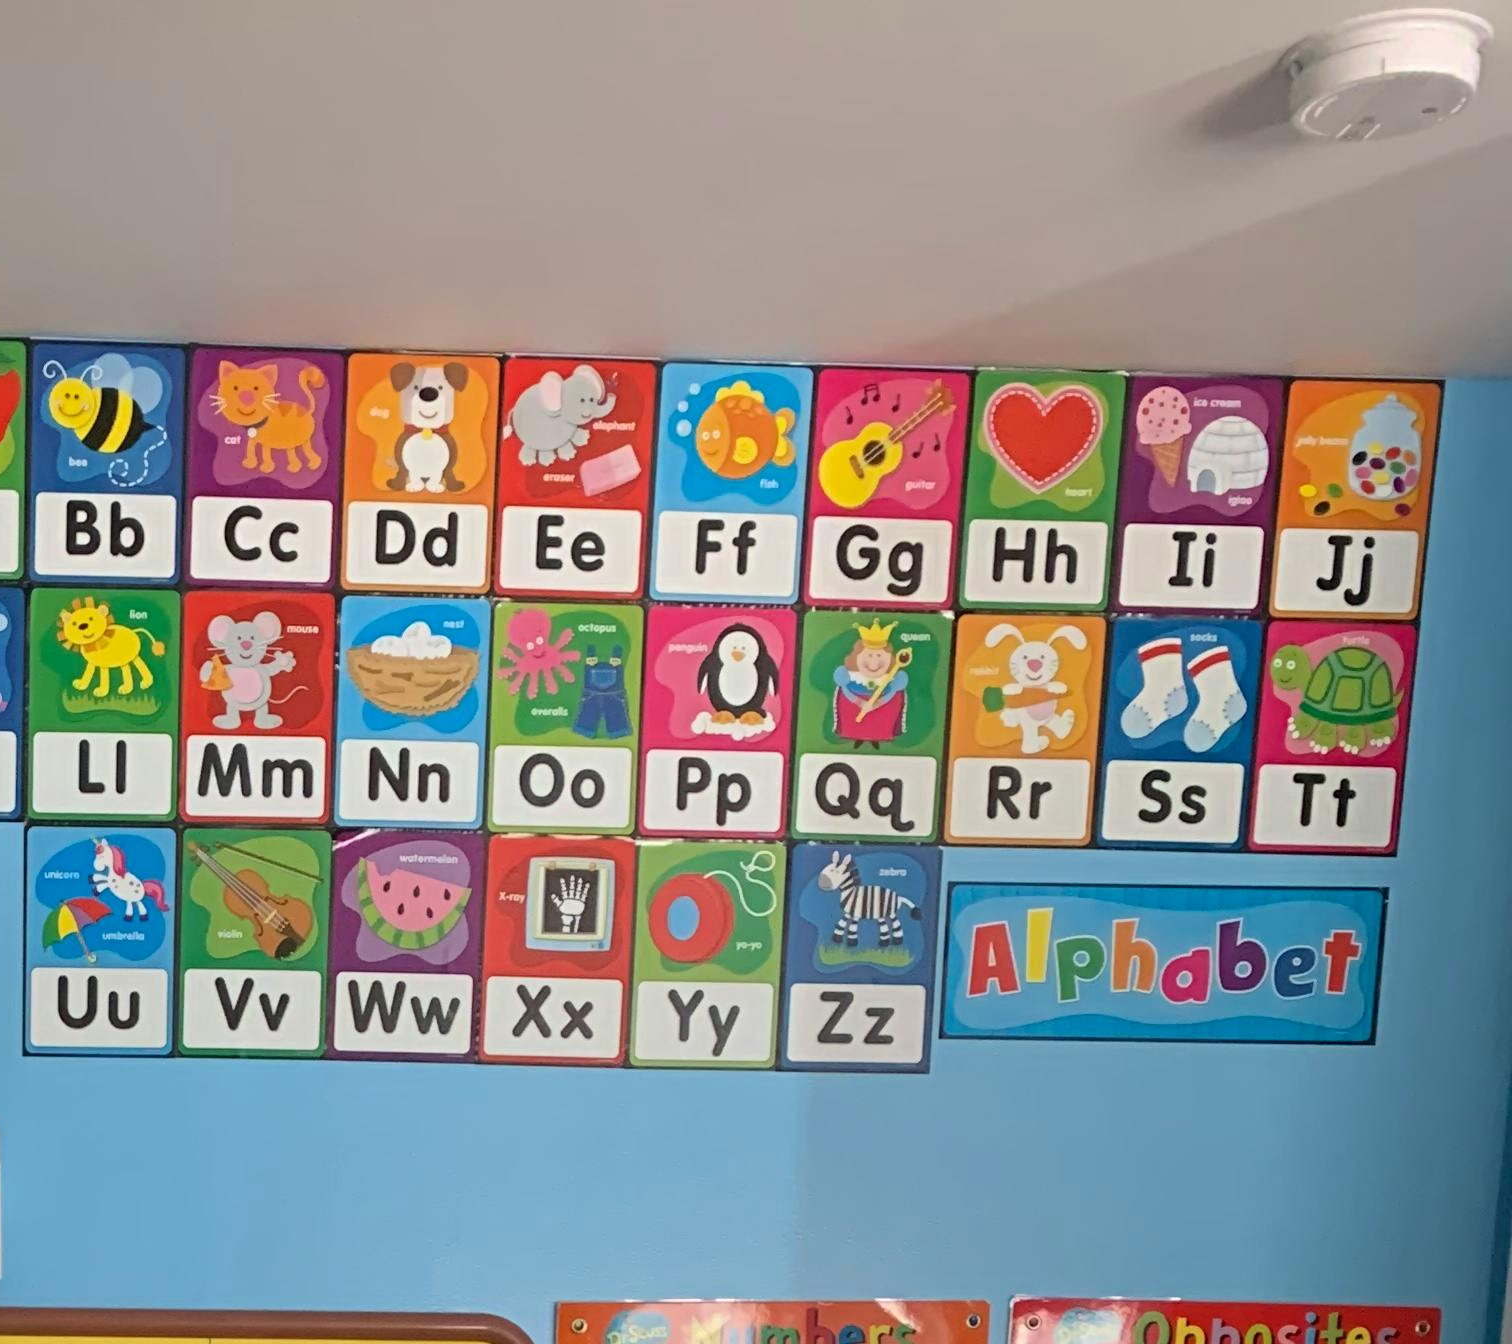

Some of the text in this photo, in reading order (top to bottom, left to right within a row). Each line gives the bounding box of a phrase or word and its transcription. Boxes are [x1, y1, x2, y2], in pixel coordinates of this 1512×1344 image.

[224, 435, 241, 445] cat
[592, 420, 636, 435] elephant
[69, 457, 88, 468] bee
[759, 479, 779, 489] fish
[905, 479, 936, 491] guitar
[66, 500, 145, 557] Bb
[224, 505, 300, 562] Cc
[375, 510, 459, 567] Dd
[536, 514, 606, 571] Ee
[695, 519, 756, 575] Ff
[992, 527, 1077, 584] Hh
[835, 524, 924, 596] Gg
[1169, 531, 1216, 587] Ii
[1317, 534, 1376, 607] Jj
[129, 609, 148, 620] lion
[287, 625, 319, 634] mouse
[578, 623, 617, 635] octopus
[1190, 632, 1218, 642] socks
[530, 706, 569, 718] overalls
[79, 739, 126, 794] Ll
[198, 742, 313, 798] Mm
[368, 747, 449, 803] Nn
[519, 753, 605, 808] Oo
[676, 757, 751, 826] Pp
[987, 765, 1052, 821] Rr
[815, 762, 914, 833] Qq
[1138, 769, 1206, 825] Ss
[1293, 772, 1356, 827] Tt
[44, 870, 80, 881] unicorn
[399, 853, 458, 865] watermelon
[499, 891, 525, 904] X-ray
[102, 930, 145, 942] umbrella
[217, 929, 243, 940] violin
[966, 907, 1361, 1005] Alphabet
[57, 975, 141, 1029] Uu
[214, 976, 290, 1032] Vv
[348, 980, 460, 1035] Ww
[512, 984, 593, 1040] Xx
[668, 988, 740, 1057] Yy
[817, 990, 895, 1046] Zz
